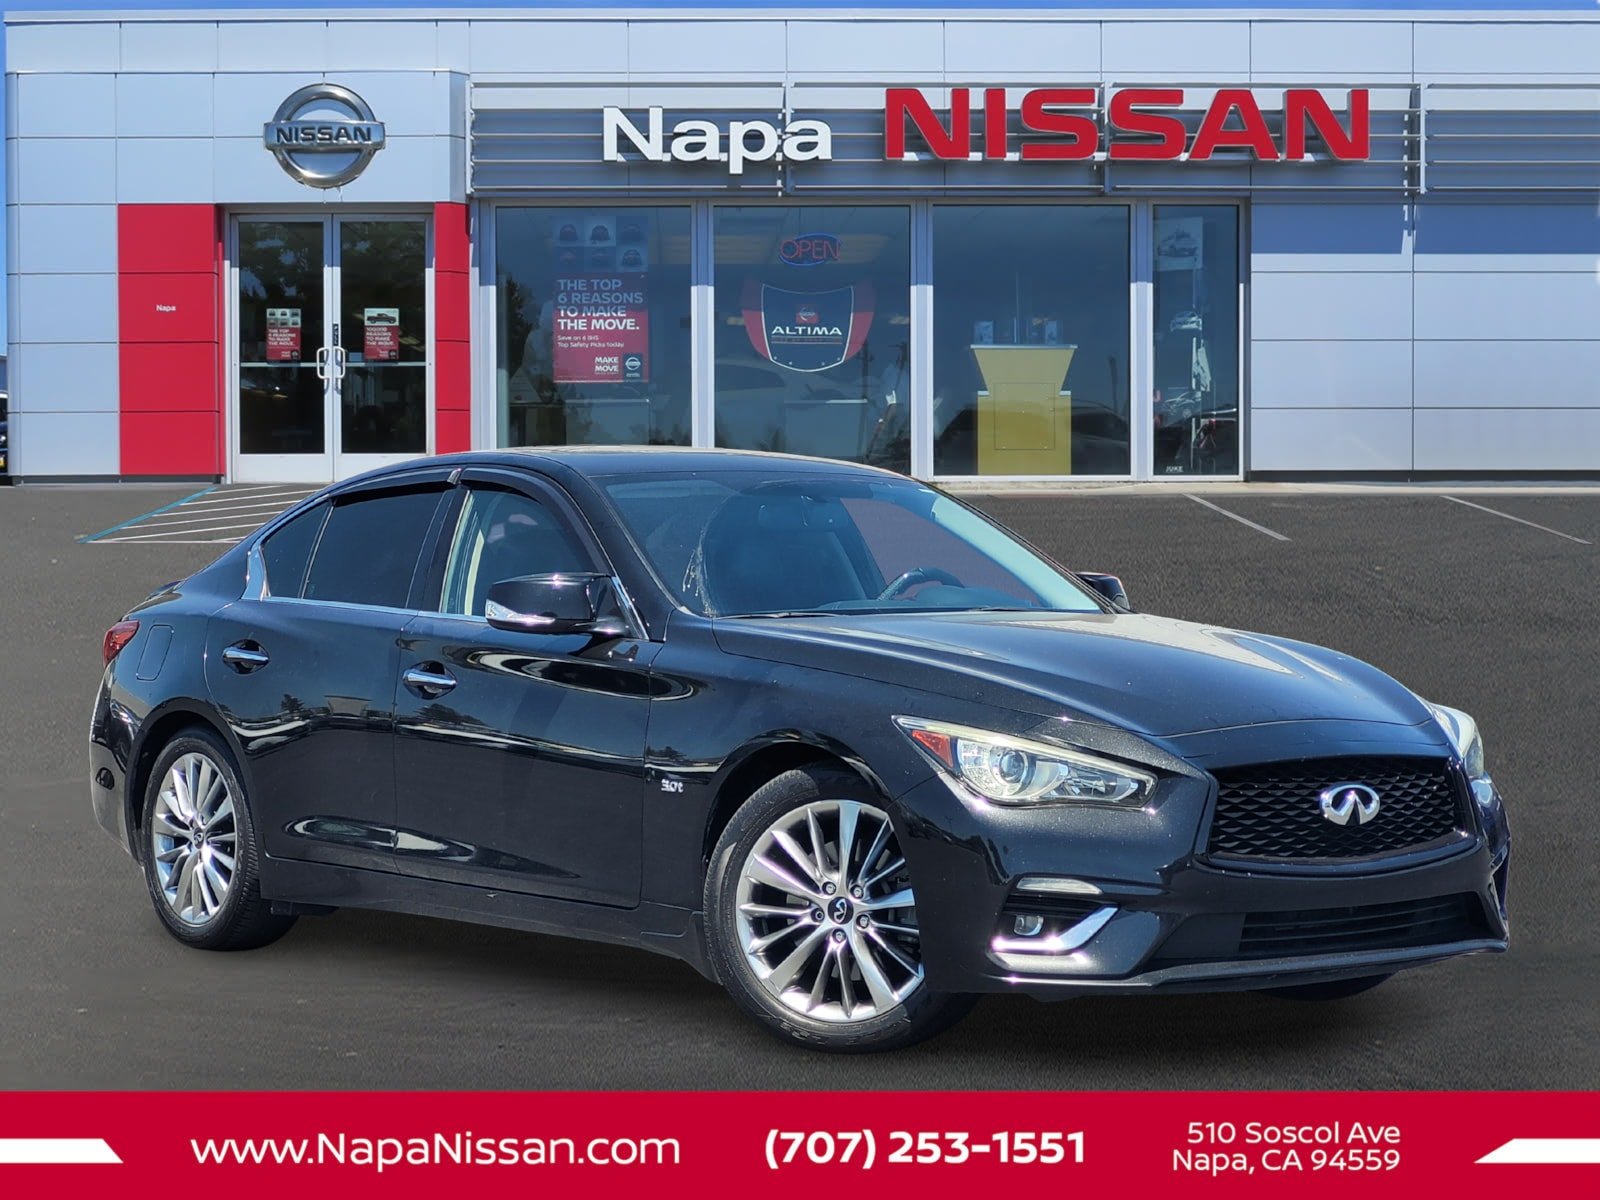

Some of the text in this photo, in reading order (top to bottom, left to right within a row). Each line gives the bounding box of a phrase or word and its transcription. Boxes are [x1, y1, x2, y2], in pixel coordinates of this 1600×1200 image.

[276, 126, 371, 143] NISSAN
[603, 88, 1369, 174] Napa NISSAN
[780, 240, 841, 260] OPEN
[558, 279, 622, 290] THE TOP
[558, 292, 643, 304] 6 REASONS
[156, 304, 176, 312] Napa
[558, 306, 626, 317] TO MAKE
[558, 319, 639, 330] THE MOVE.
[772, 326, 842, 335] ALTIMA
